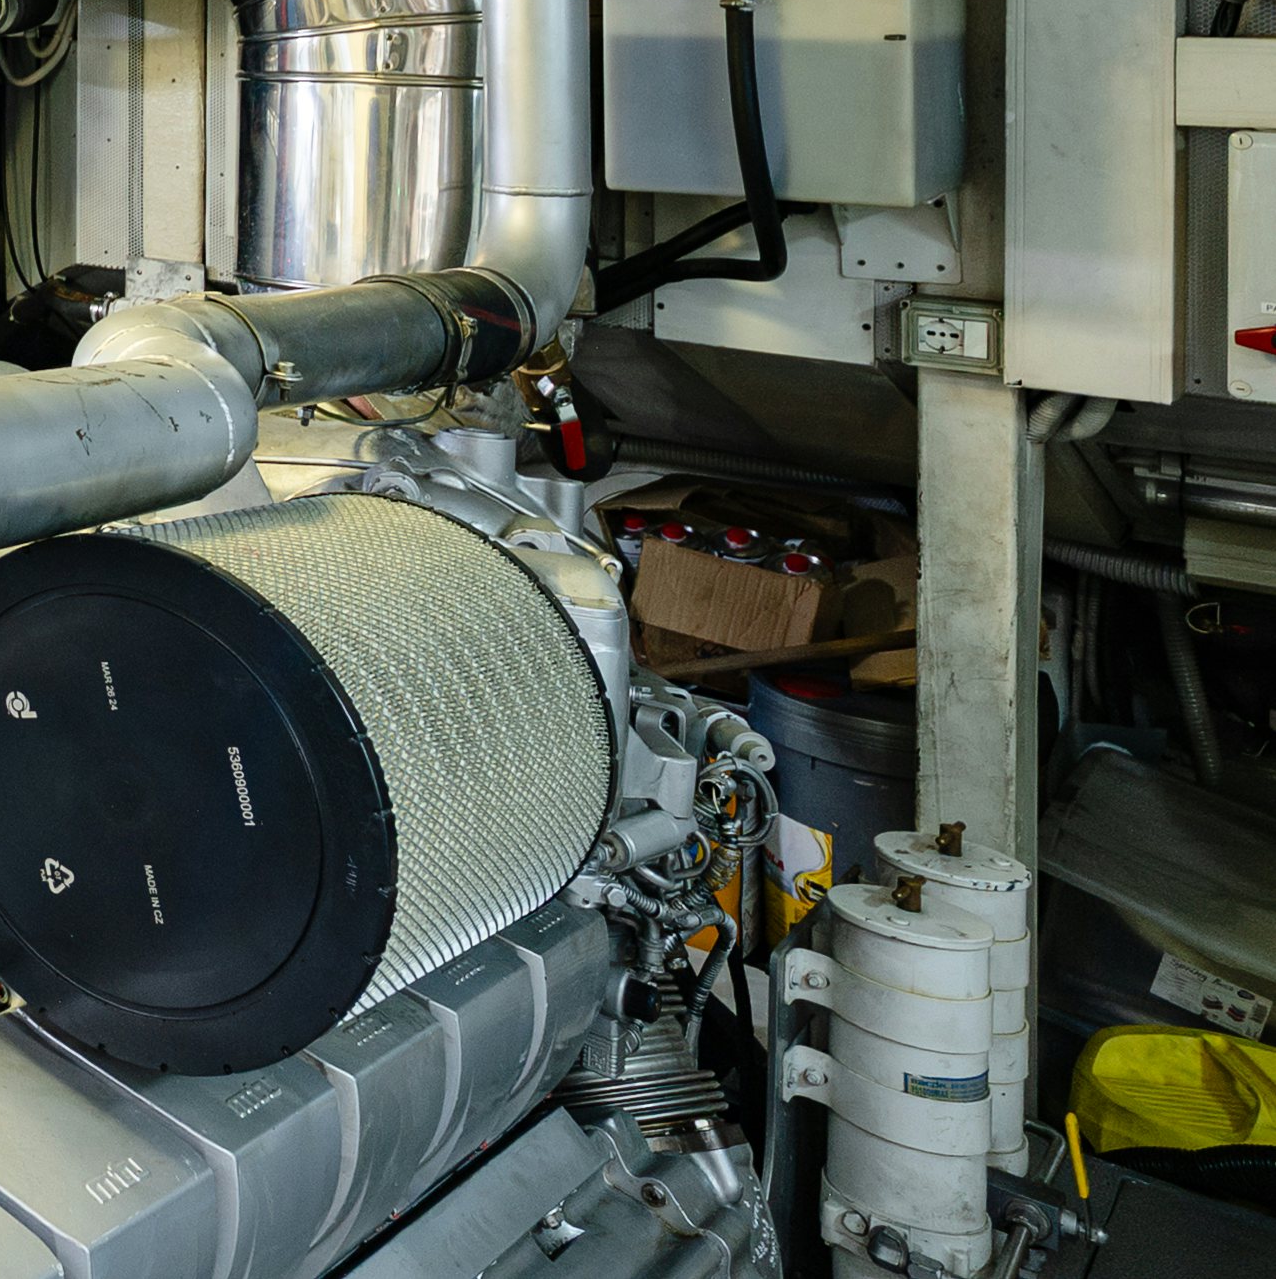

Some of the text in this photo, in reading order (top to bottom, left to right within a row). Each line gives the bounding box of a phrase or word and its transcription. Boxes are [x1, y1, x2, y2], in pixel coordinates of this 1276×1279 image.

[101, 661, 118, 711] MAR 26 24
[228, 746, 256, 826] 5360900001
[144, 864, 164, 925] MADE IN CZ
